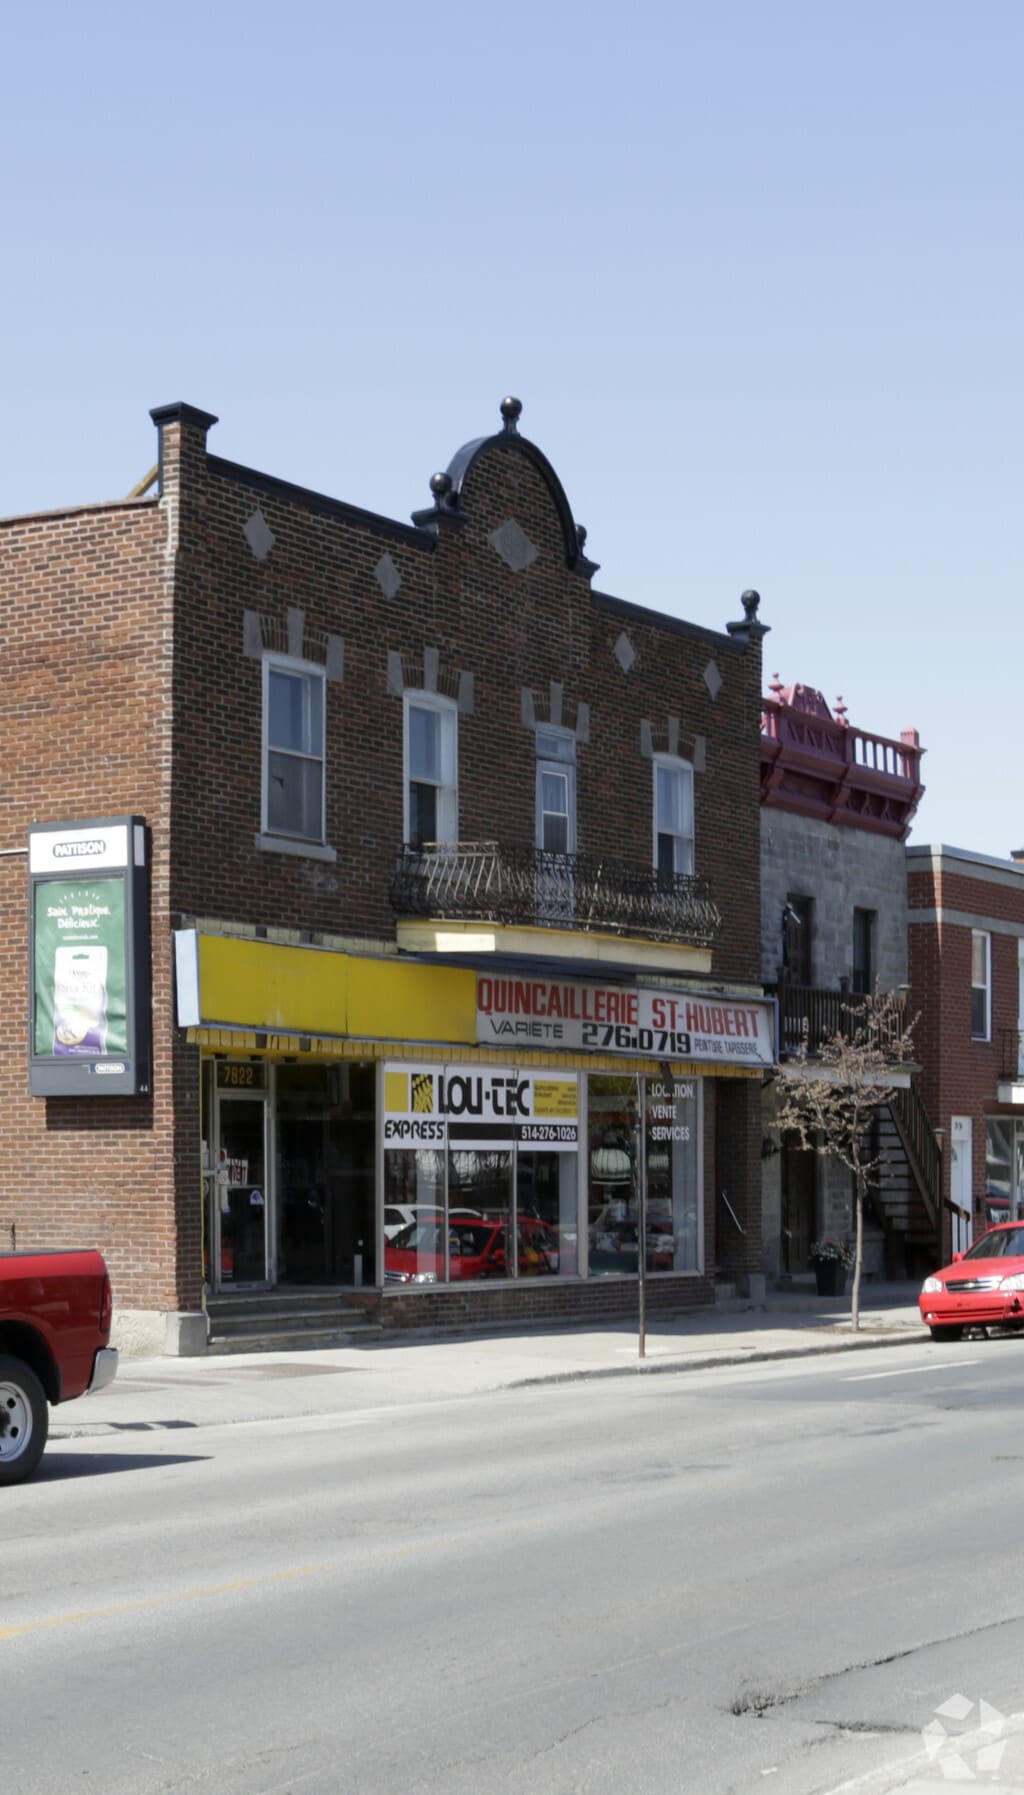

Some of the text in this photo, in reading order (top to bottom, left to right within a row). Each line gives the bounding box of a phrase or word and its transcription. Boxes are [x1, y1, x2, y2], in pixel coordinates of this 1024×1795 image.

[54, 841, 105, 857] PATTISON
[477, 978, 760, 1038] QUINCAILLERIE ST-HUBERT
[224, 1066, 253, 1085] 7822
[651, 1083, 694, 1098] LOCTION
[651, 1104, 677, 1119] VENTE
[384, 1119, 445, 1140] EXPRESS
[521, 1125, 577, 1141] 514-276-1026
[651, 1126, 690, 1141] SERVICES
